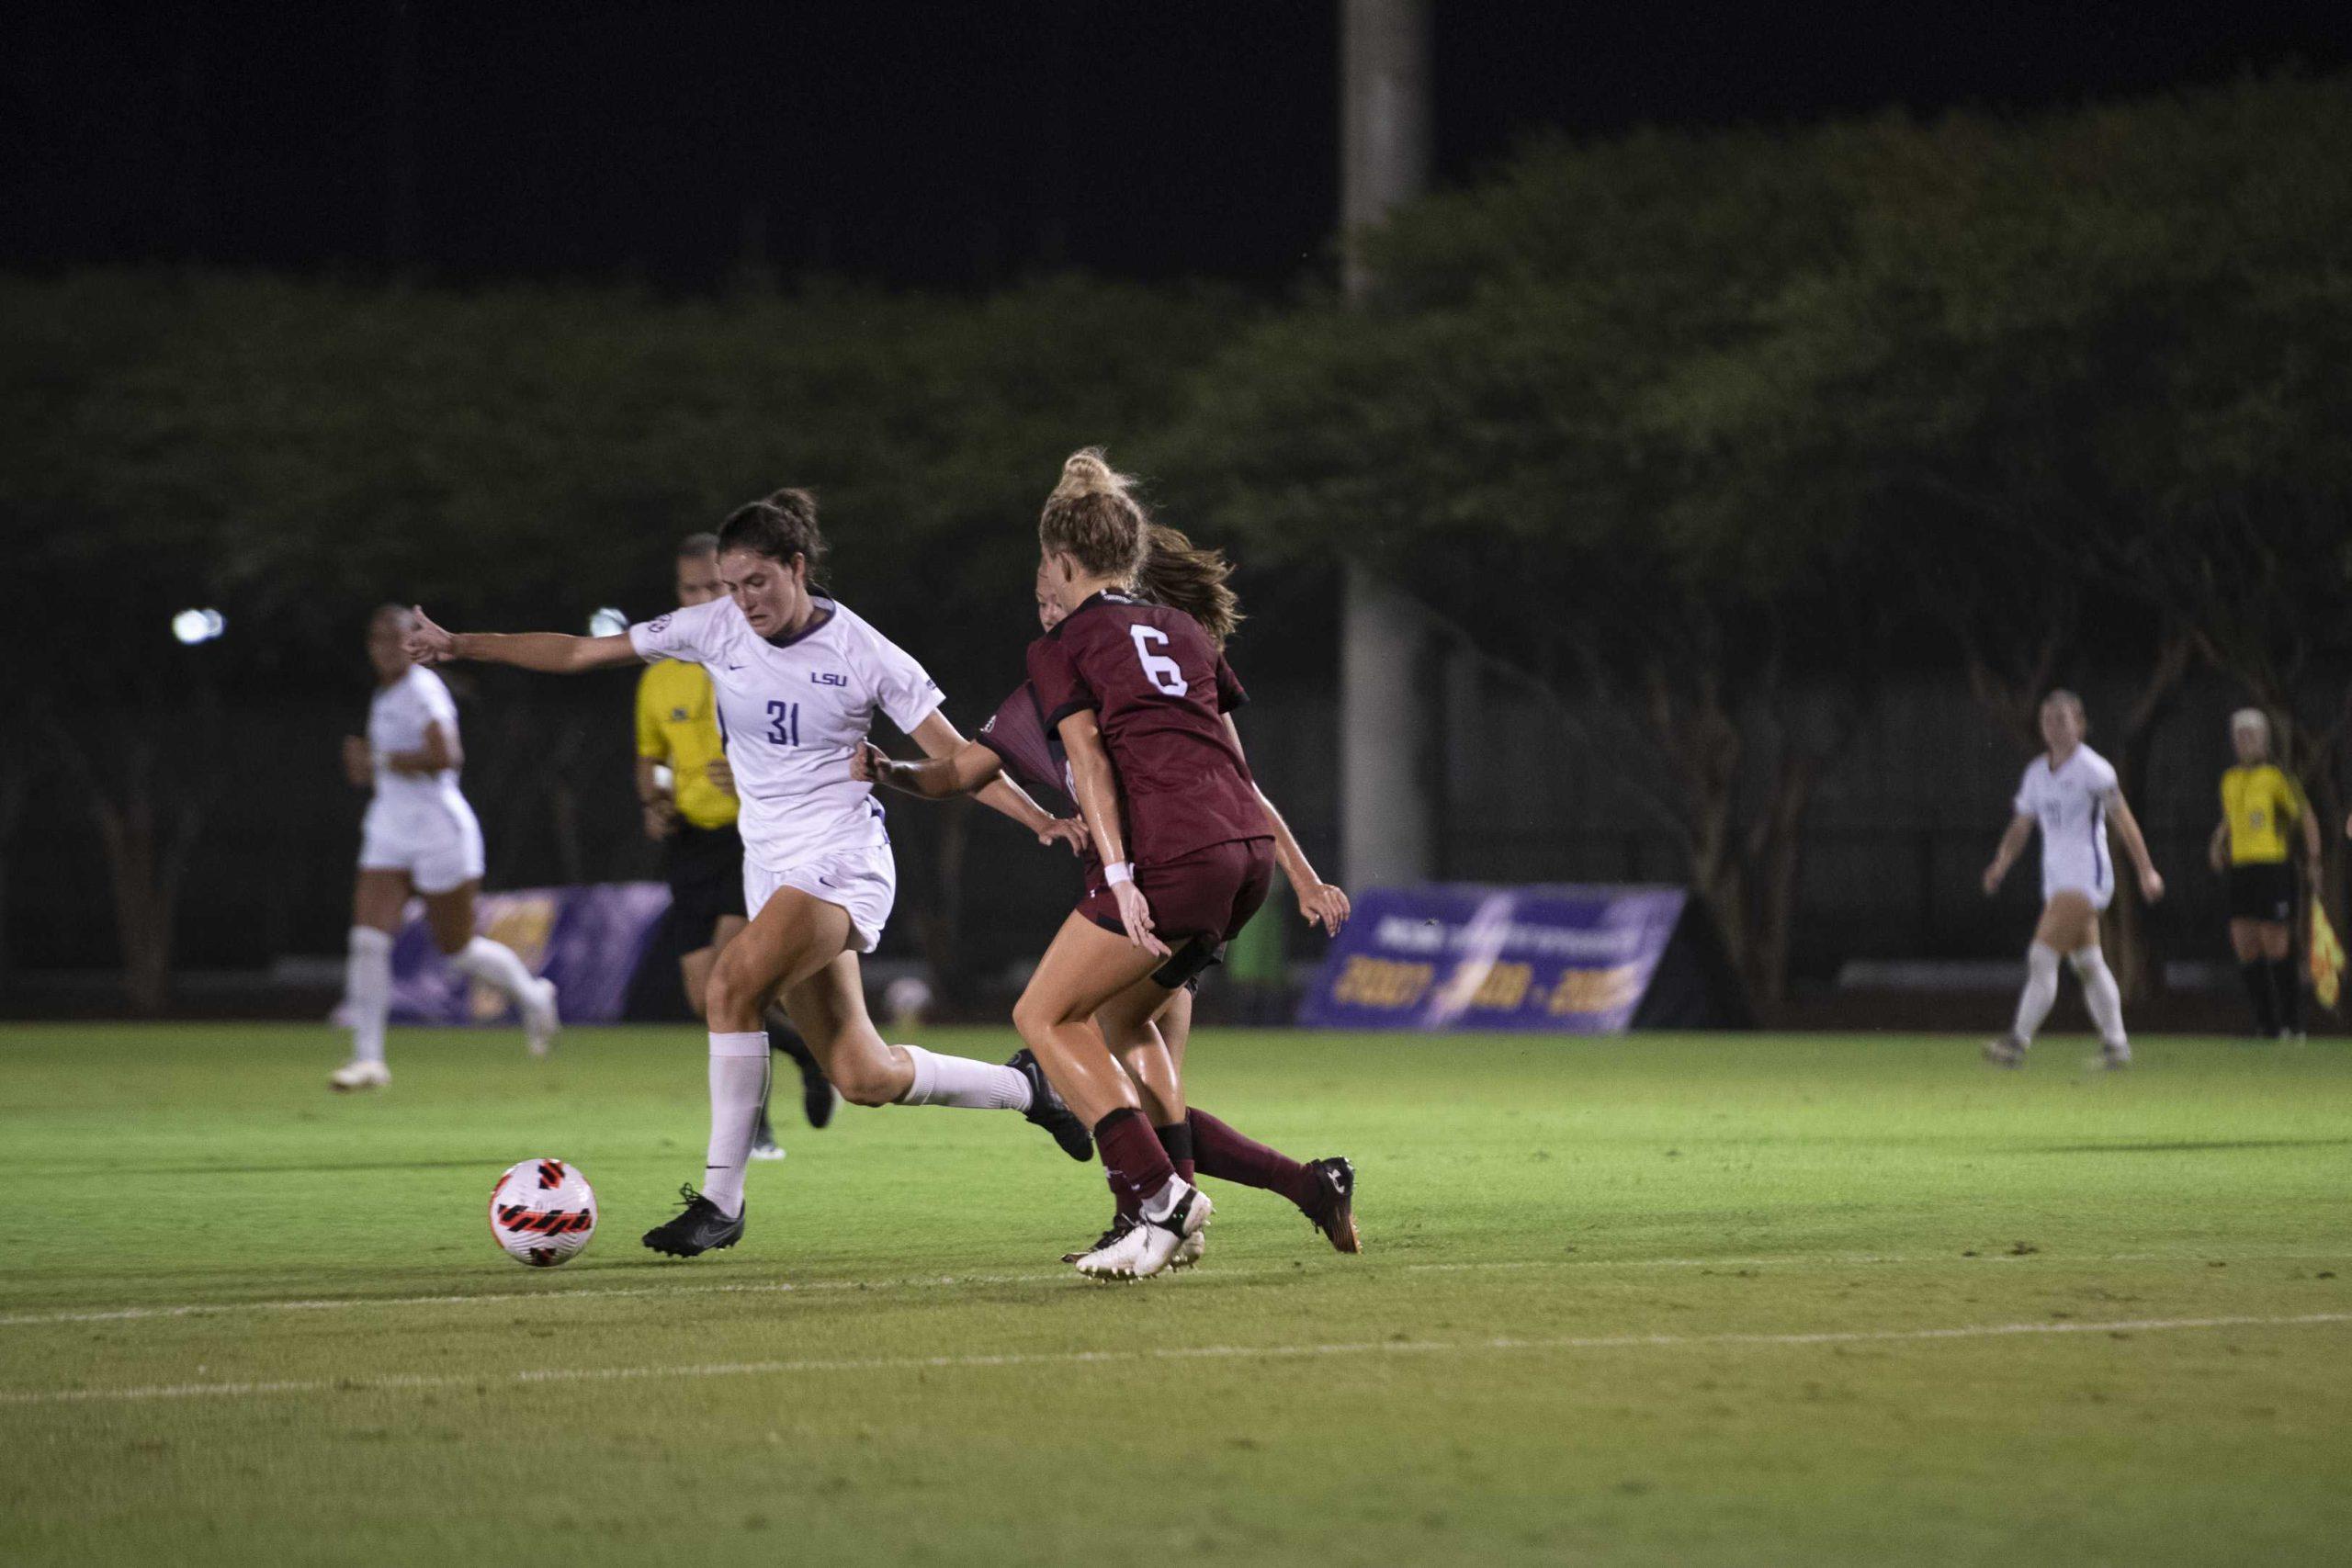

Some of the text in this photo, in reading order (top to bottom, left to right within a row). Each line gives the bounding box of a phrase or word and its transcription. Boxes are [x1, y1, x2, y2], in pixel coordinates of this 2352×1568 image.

[811, 671, 847, 687] LSU
[1130, 624, 1188, 697] 6
[767, 700, 798, 747] 31
